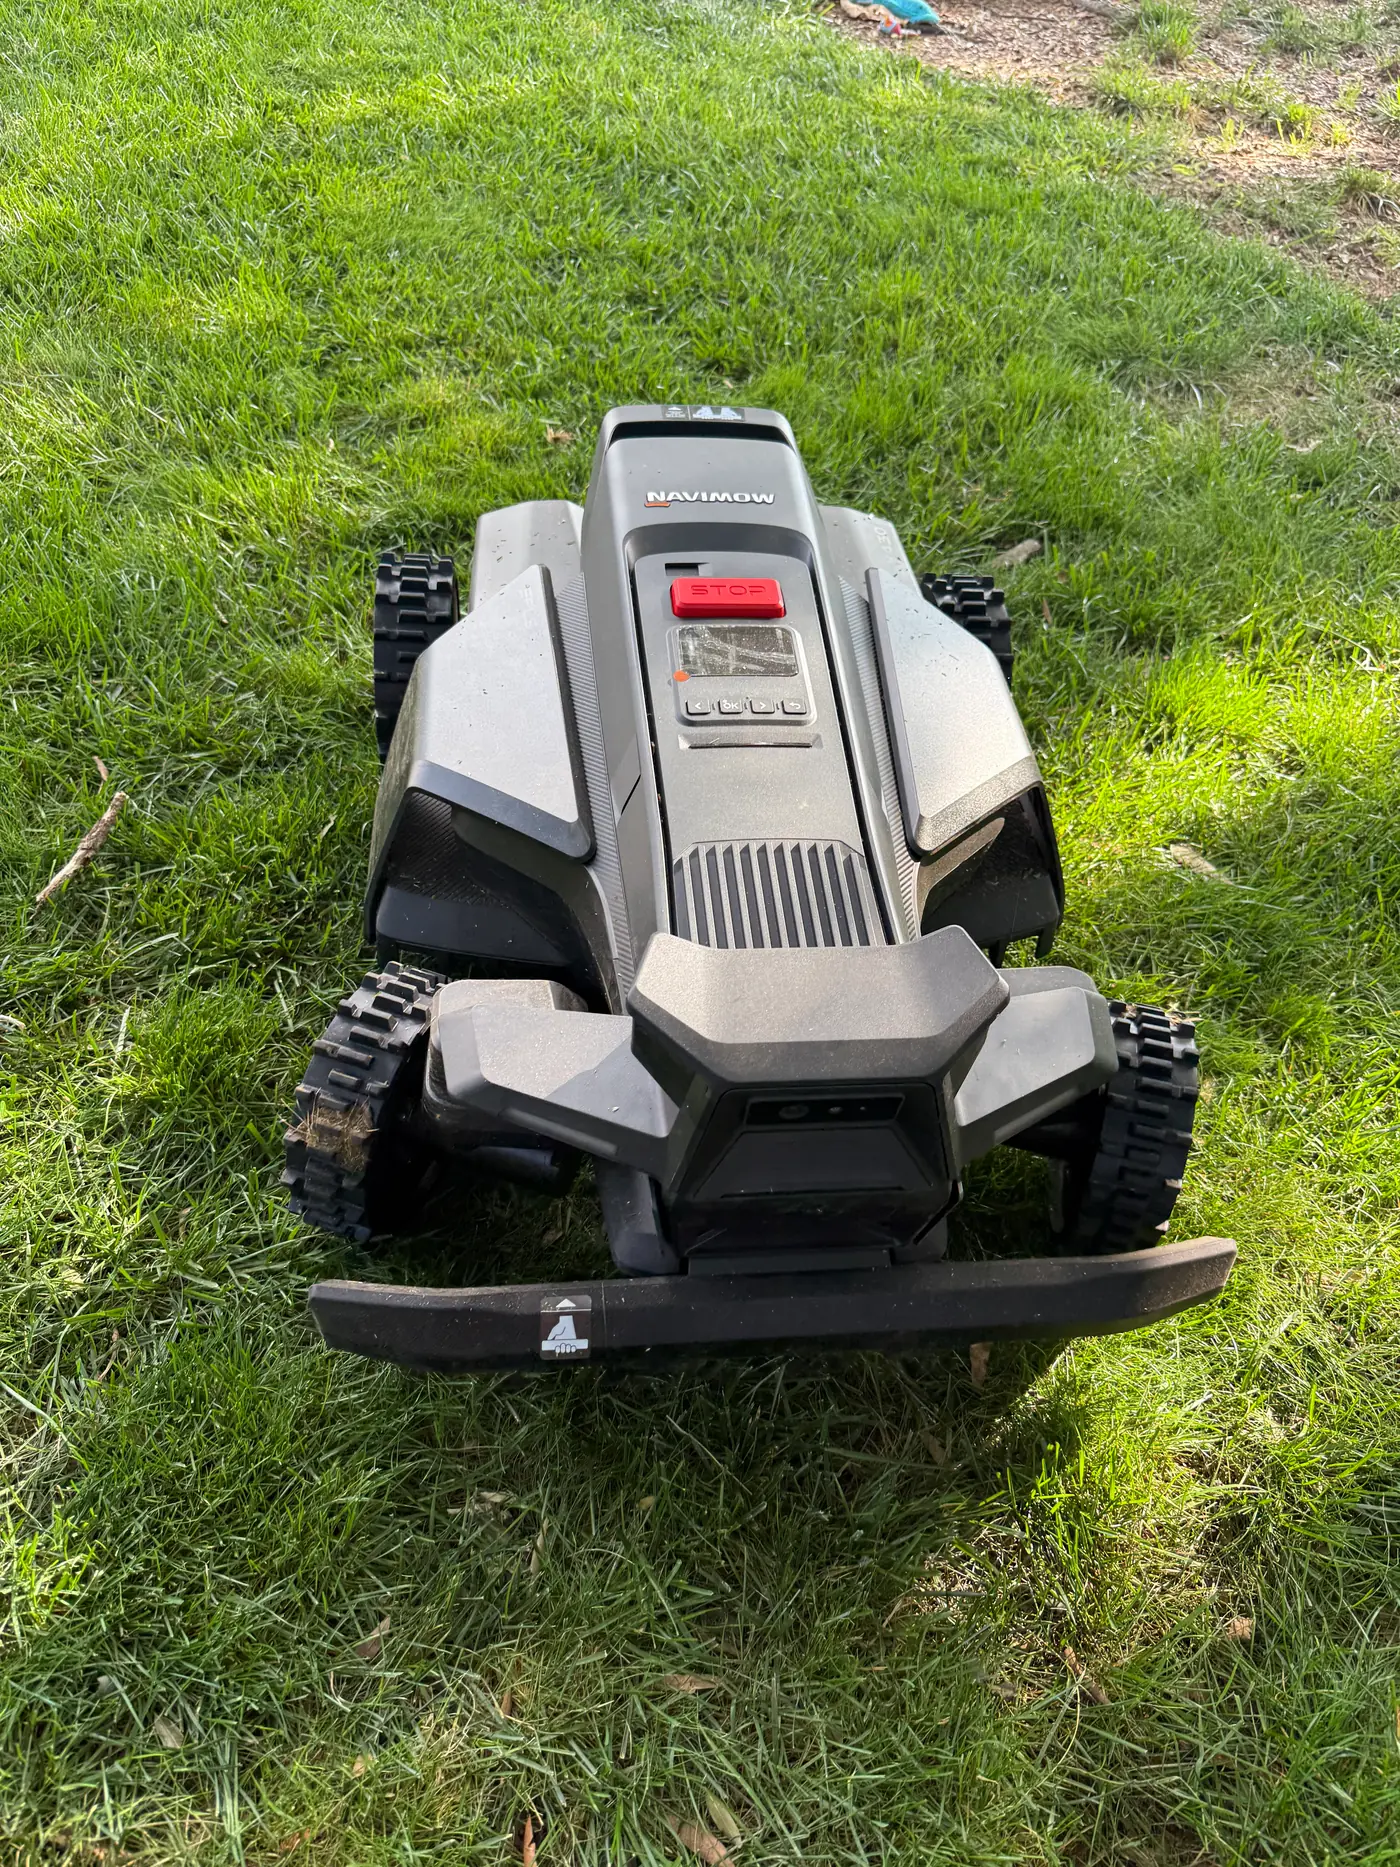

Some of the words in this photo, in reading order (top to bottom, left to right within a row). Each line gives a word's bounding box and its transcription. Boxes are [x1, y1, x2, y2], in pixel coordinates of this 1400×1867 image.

[645, 491, 775, 504] NAVIMOW
[690, 585, 766, 596] STOP
[722, 702, 739, 710] OK
